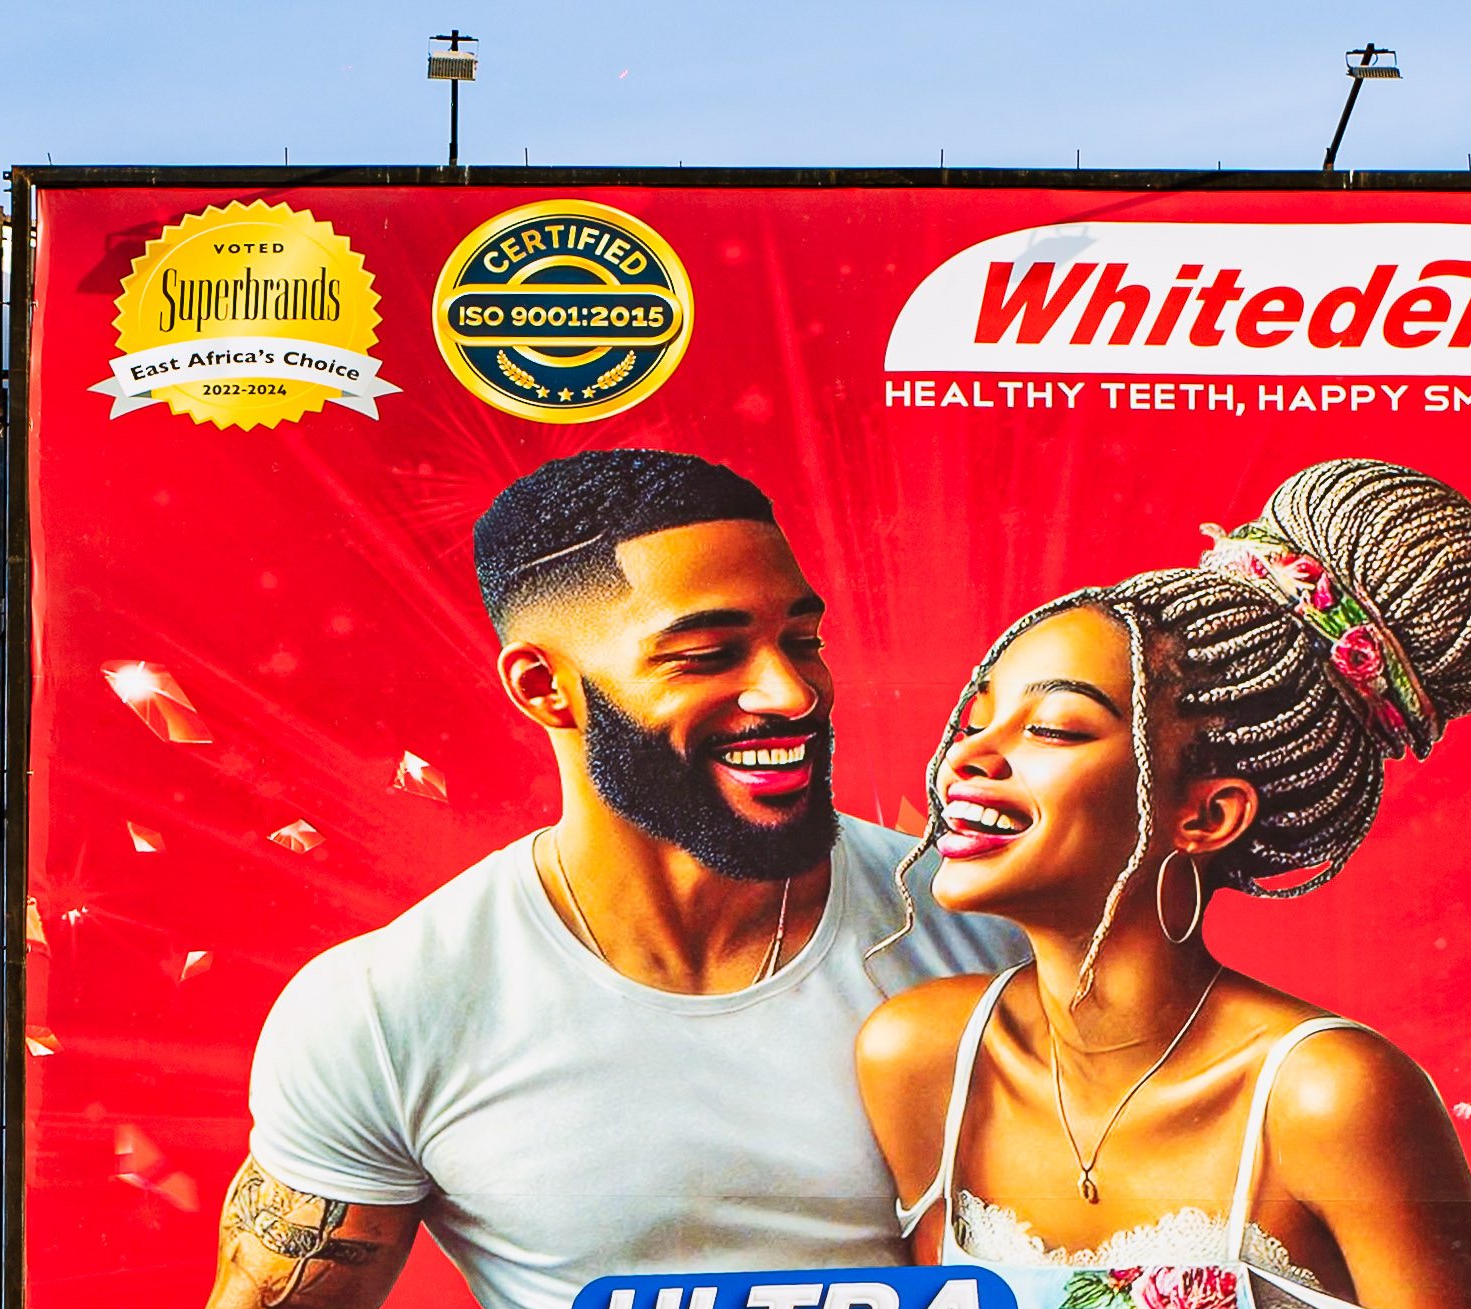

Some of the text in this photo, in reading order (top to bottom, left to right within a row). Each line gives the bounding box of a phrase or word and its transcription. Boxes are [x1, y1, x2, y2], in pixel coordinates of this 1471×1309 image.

[213, 243, 285, 254] VOTED
[482, 224, 648, 275] CERTIFIED
[159, 267, 341, 332] Superbrands
[459, 306, 665, 327] ISO 9001:2015
[130, 349, 360, 381] East Africa's Choice
[202, 384, 288, 396] 2022-2024
[886, 381, 1085, 409] HEALTHY
[1102, 382, 1246, 416] TEETH,
[1258, 385, 1409, 412] HAPPY
